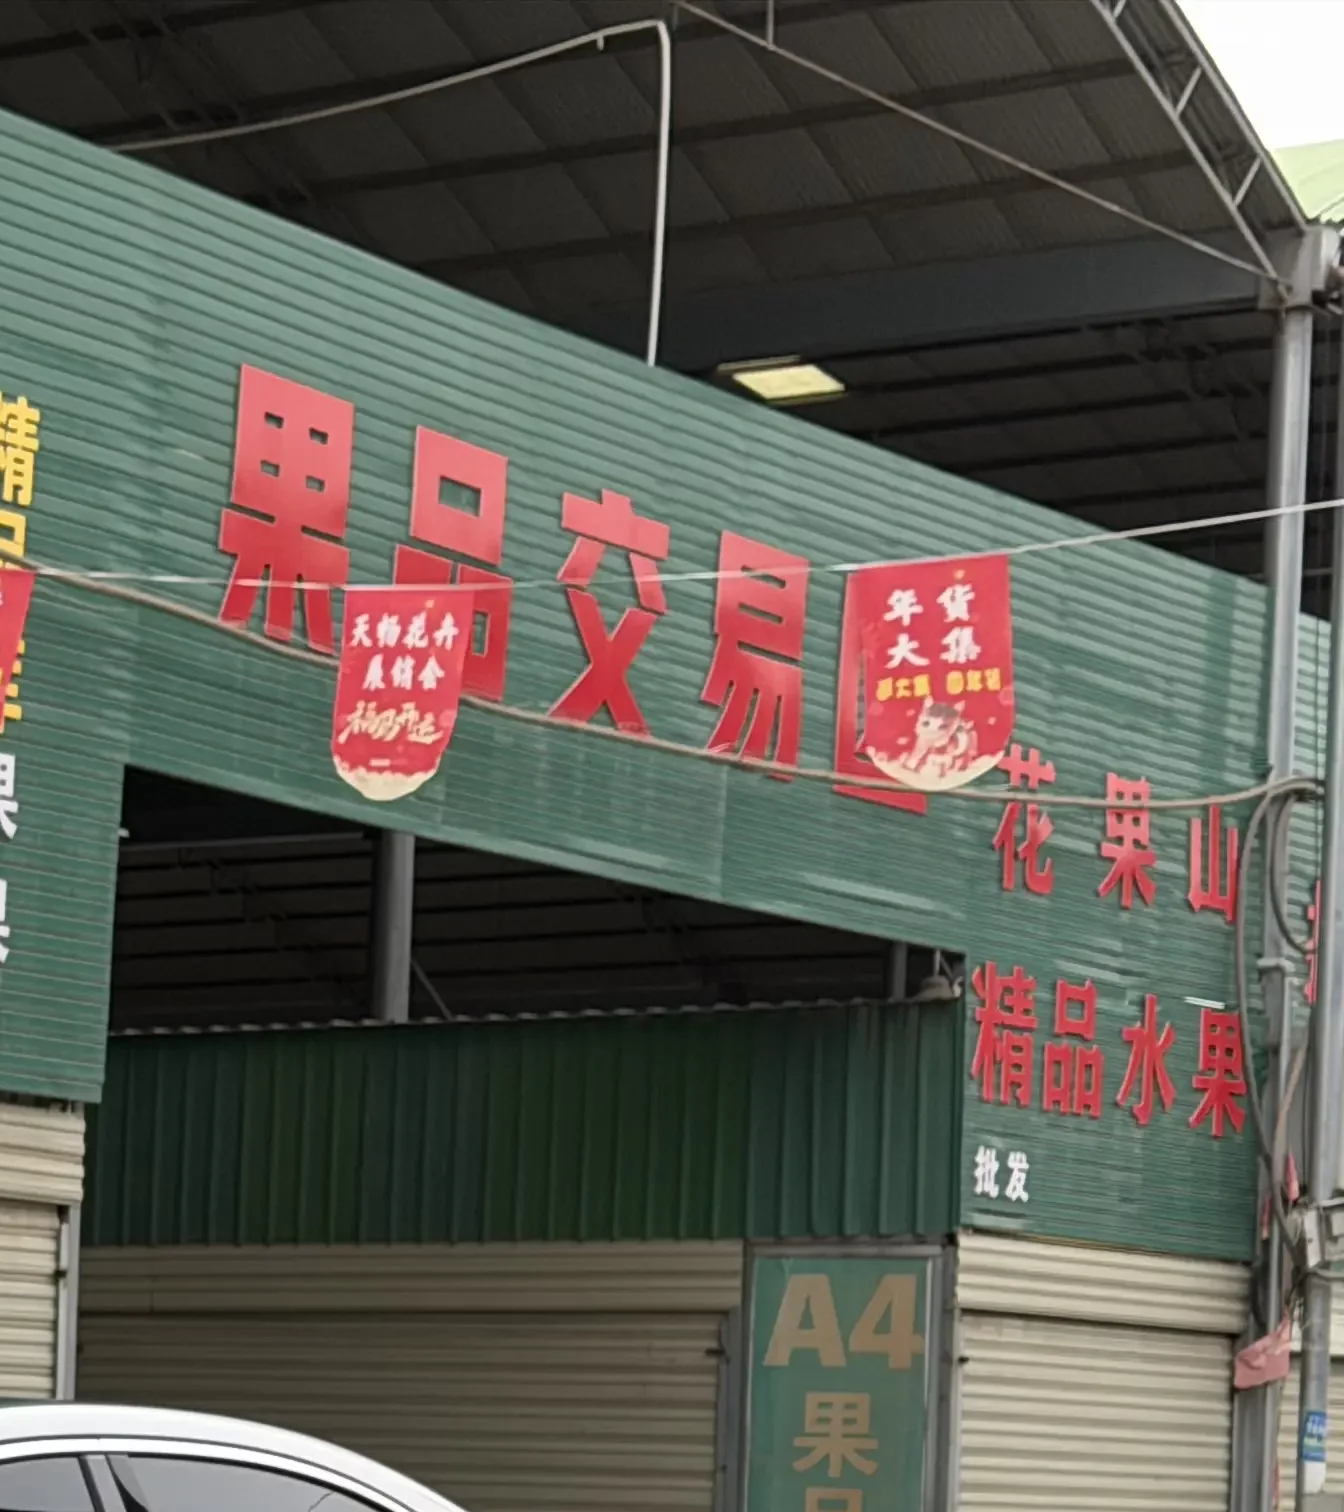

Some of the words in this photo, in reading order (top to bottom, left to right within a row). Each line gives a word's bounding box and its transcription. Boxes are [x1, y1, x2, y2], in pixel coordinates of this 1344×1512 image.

[993, 745, 1240, 928] 花果山
[970, 960, 1248, 1140] 精品水果
[973, 1144, 1031, 1203] 批发
[763, 1272, 925, 1370] A4
